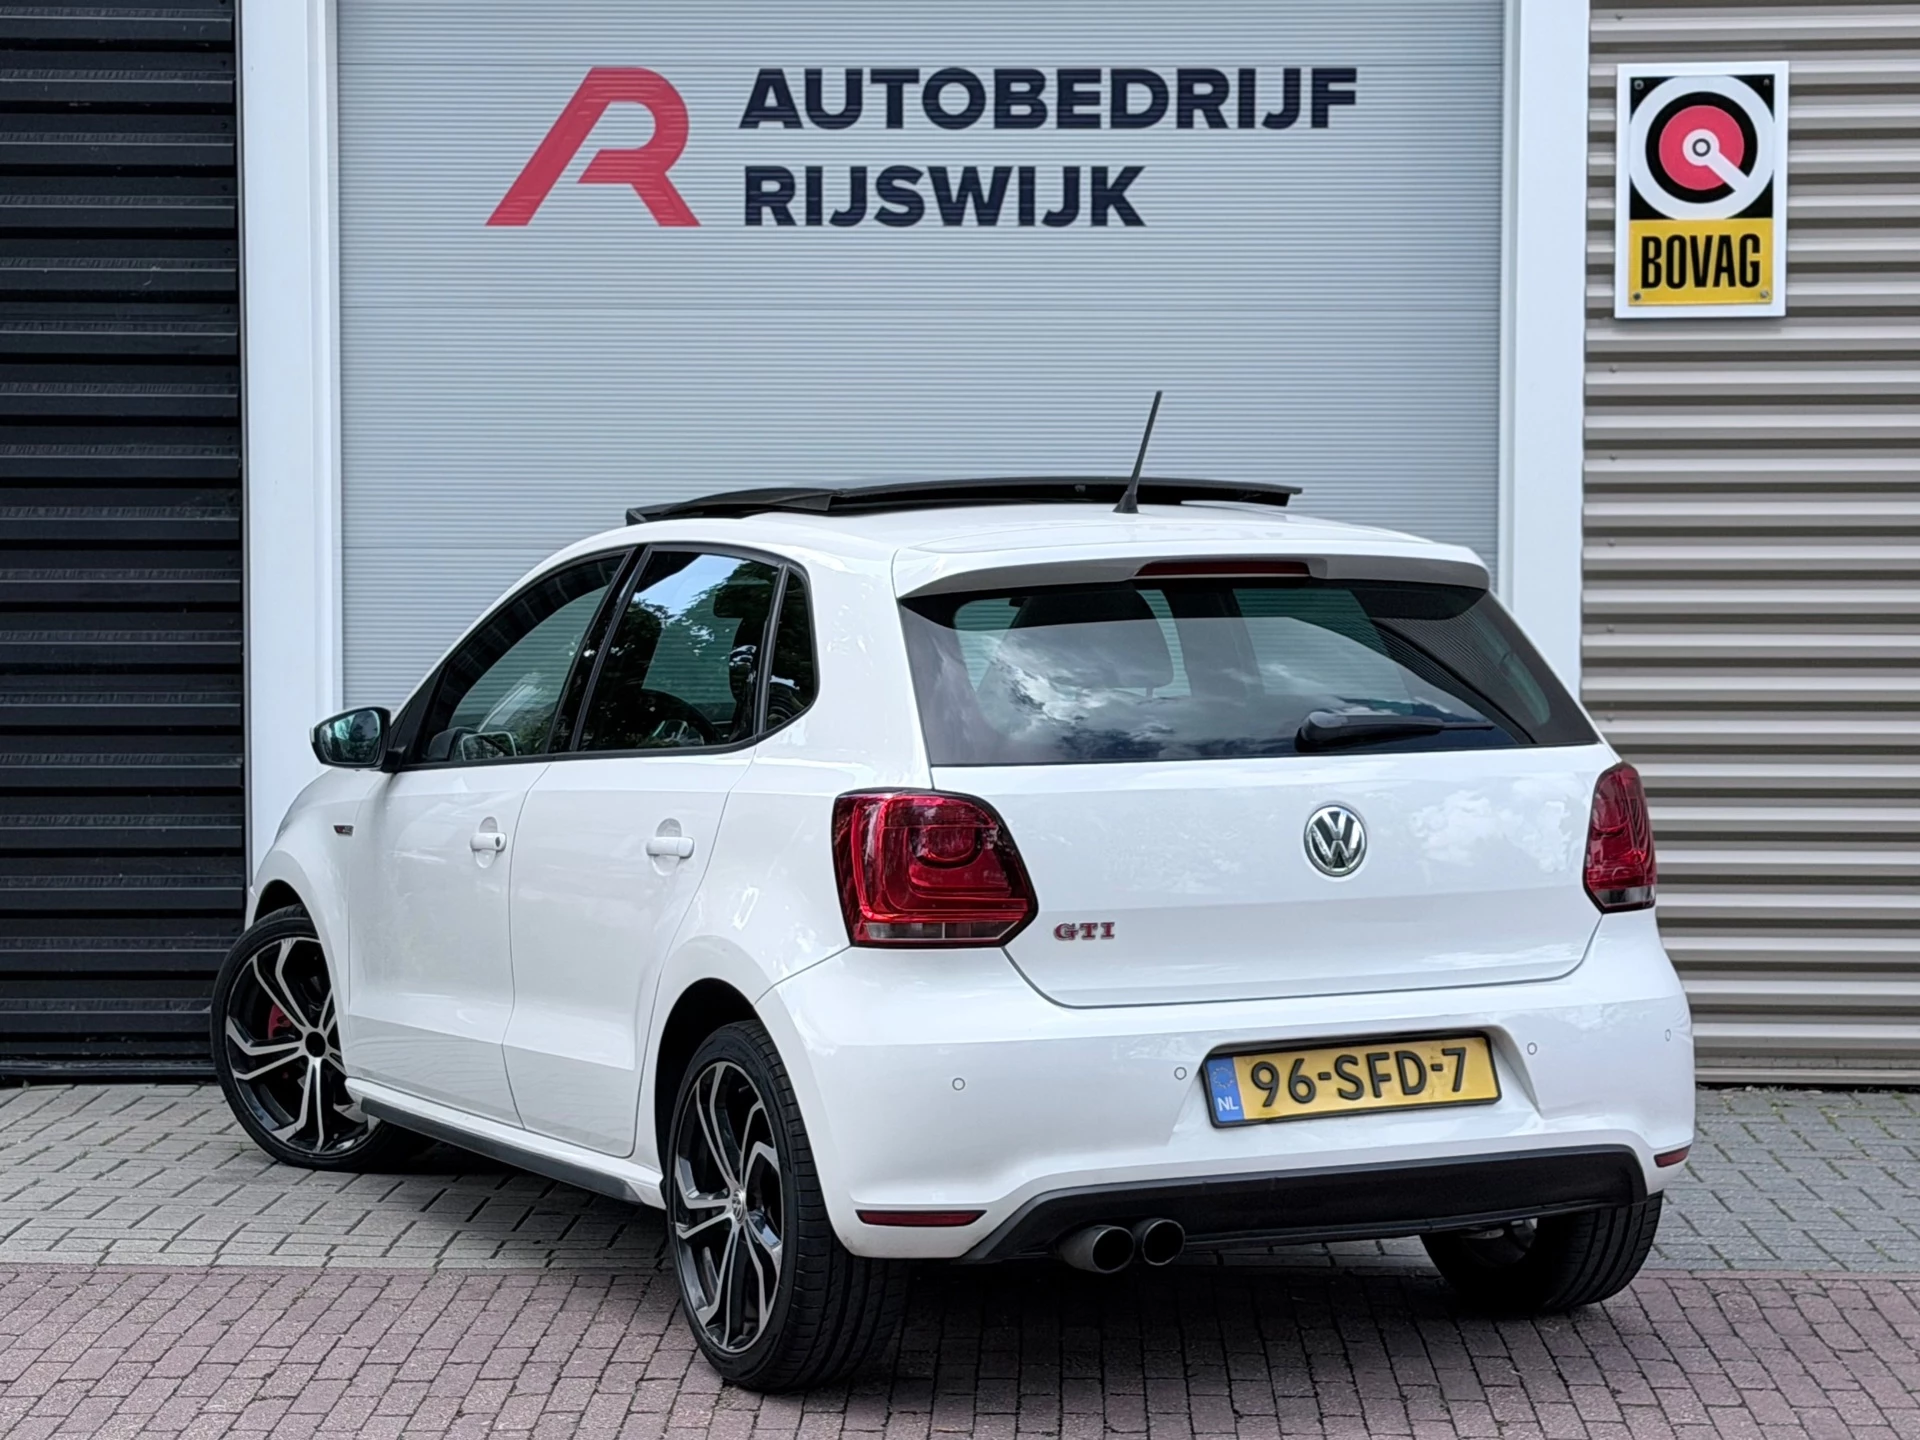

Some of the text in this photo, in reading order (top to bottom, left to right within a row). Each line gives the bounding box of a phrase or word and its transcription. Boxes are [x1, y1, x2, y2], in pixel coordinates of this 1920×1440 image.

[738, 67, 1358, 130] AUTOBEDRIJF
[744, 165, 1146, 227] RIJSWIJK
[1641, 234, 1761, 289] BOVAG
[1053, 921, 1116, 942] GTI
[1217, 1096, 1240, 1111] NL
[1251, 1047, 1467, 1107] 96-SFD-7
